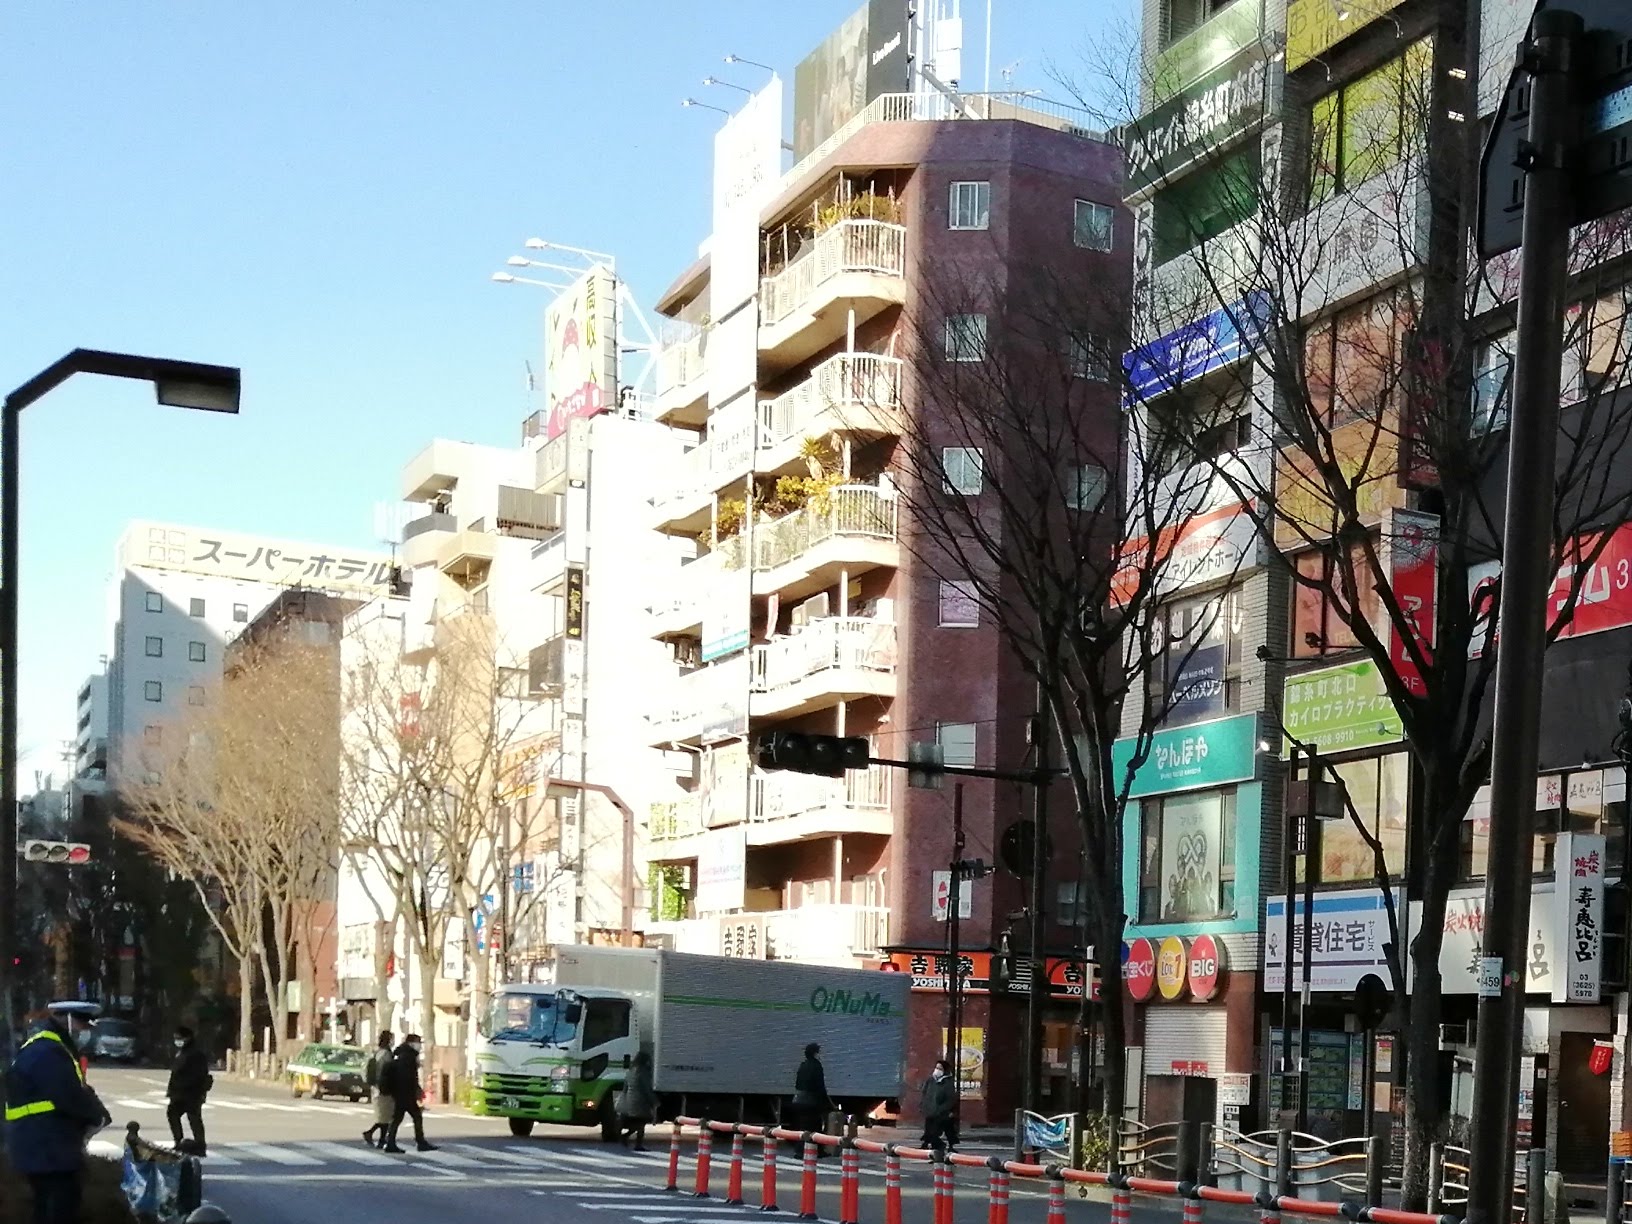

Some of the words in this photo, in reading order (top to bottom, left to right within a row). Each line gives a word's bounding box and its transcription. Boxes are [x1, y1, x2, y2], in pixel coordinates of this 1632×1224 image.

[192, 538, 391, 586] スーパーホテル
[1289, 695, 1394, 728] カイロプラクティッ
[1191, 958, 1215, 978] BIG
